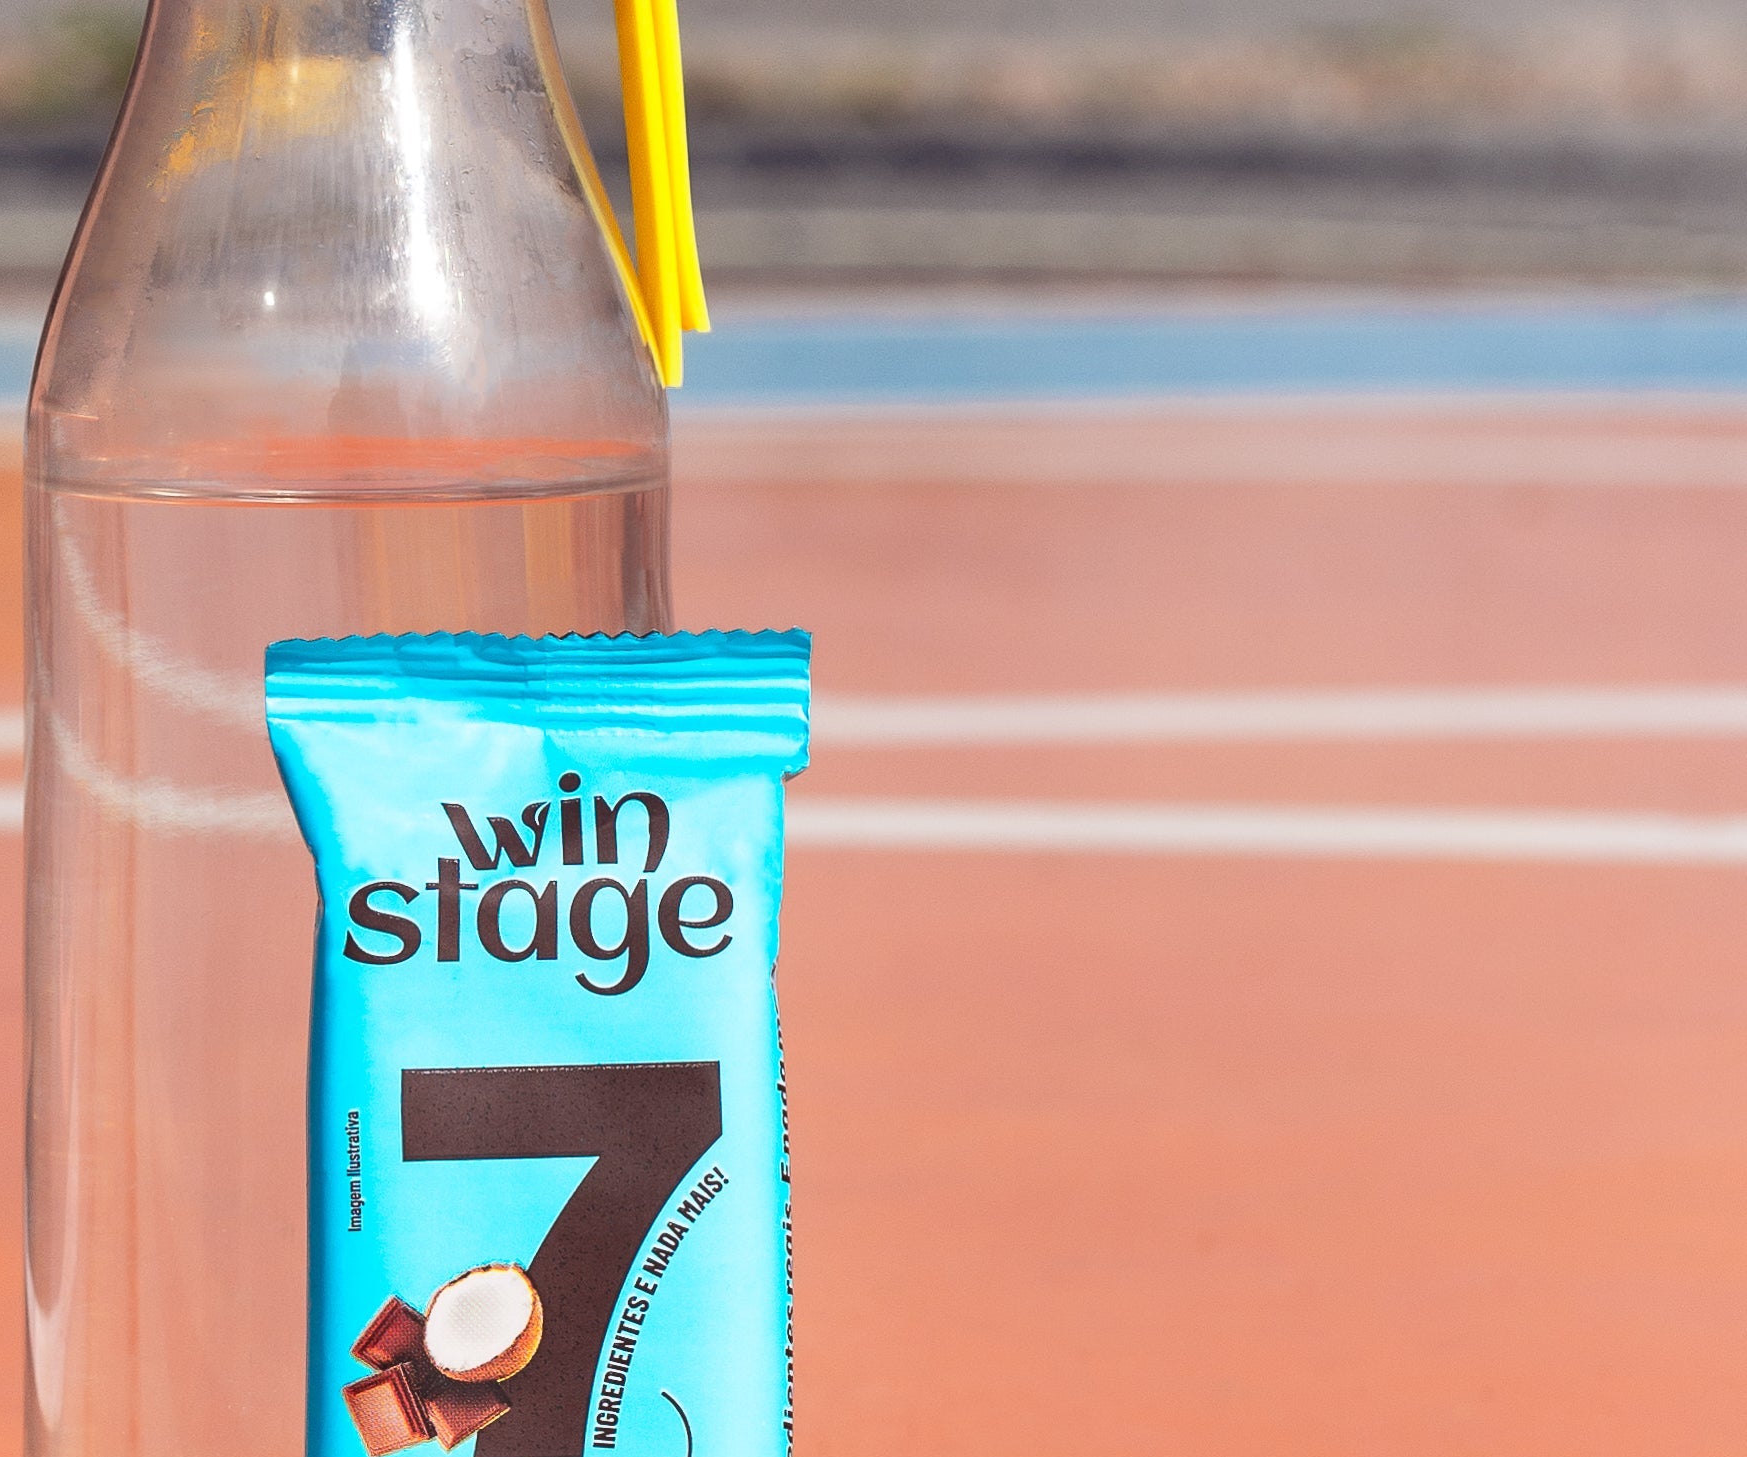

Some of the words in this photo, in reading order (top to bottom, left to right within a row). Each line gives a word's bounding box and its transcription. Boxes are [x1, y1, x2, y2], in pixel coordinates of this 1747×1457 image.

[440, 772, 670, 873] win
[343, 857, 734, 996] stage
[348, 1180, 364, 1231] Imagem
[676, 1166, 729, 1223] MAIS!
[642, 1221, 689, 1278] NADA
[634, 1277, 658, 1295] E
[593, 1296, 650, 1450] INGREDIENTES
